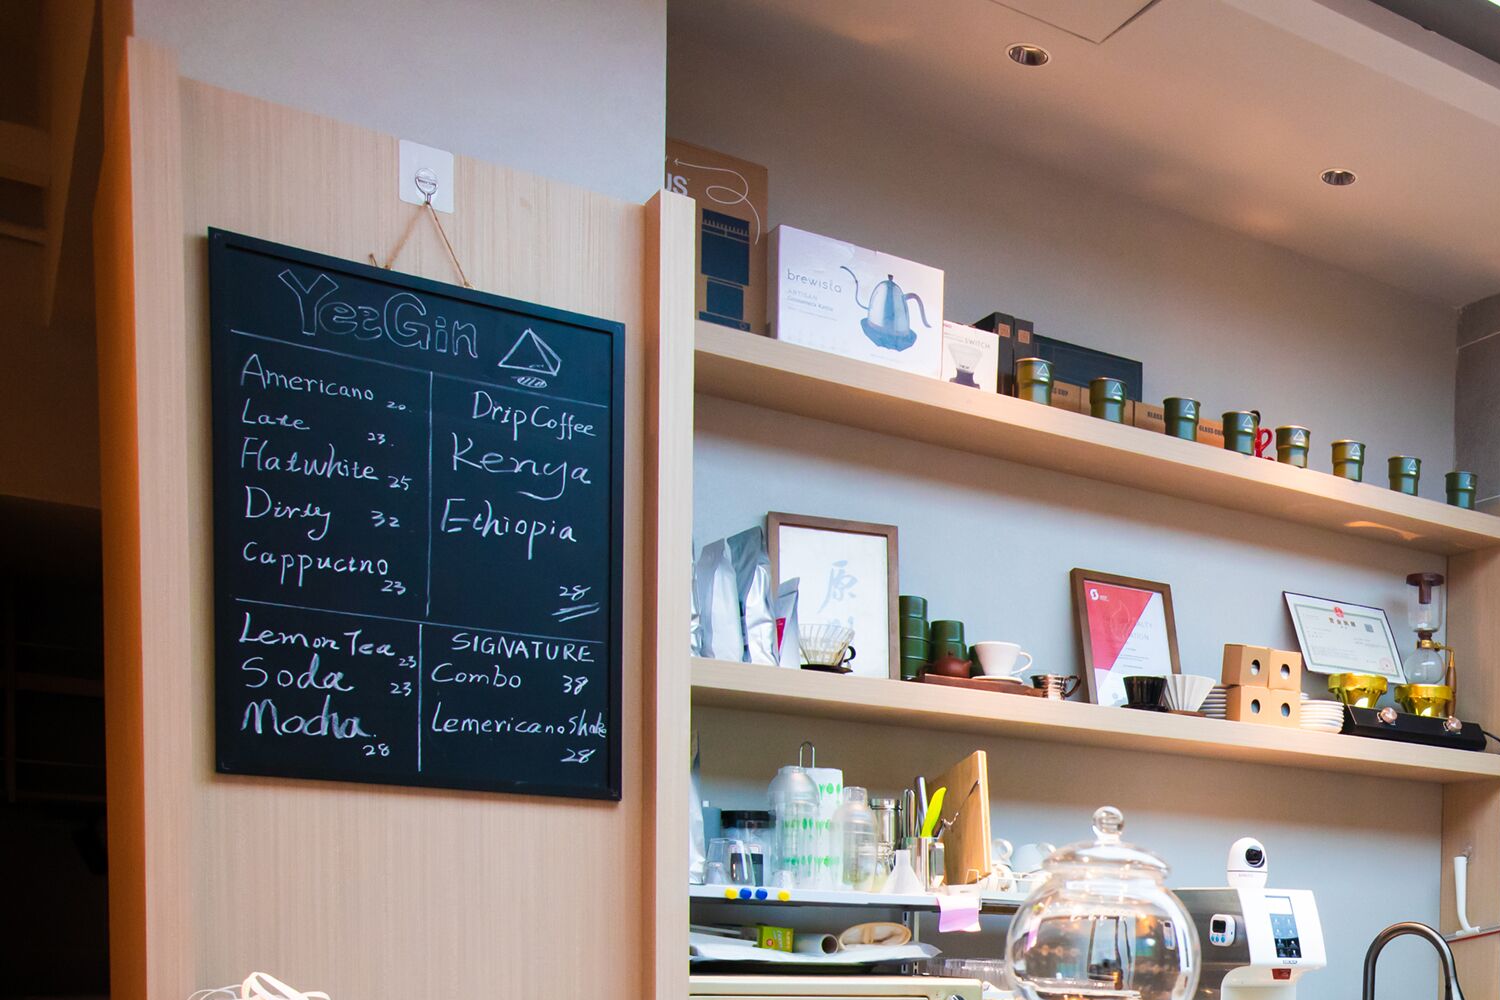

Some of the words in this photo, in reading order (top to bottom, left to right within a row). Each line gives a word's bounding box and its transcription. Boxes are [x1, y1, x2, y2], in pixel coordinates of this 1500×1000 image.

[787, 268, 842, 294] brewista
[240, 353, 374, 400] Americano
[452, 432, 591, 500] Kenya
[388, 475, 412, 491] 25
[371, 510, 400, 527] 32
[441, 498, 577, 560] Ethiopia
[381, 579, 406, 595] 23
[451, 632, 595, 662] SIGNATURE
[242, 653, 355, 692] Soda
[390, 681, 412, 696] 23
[399, 655, 417, 668] 23
[431, 662, 521, 688] Combo
[562, 675, 589, 695] 38
[363, 743, 390, 757] 28
[560, 748, 596, 763] 28
